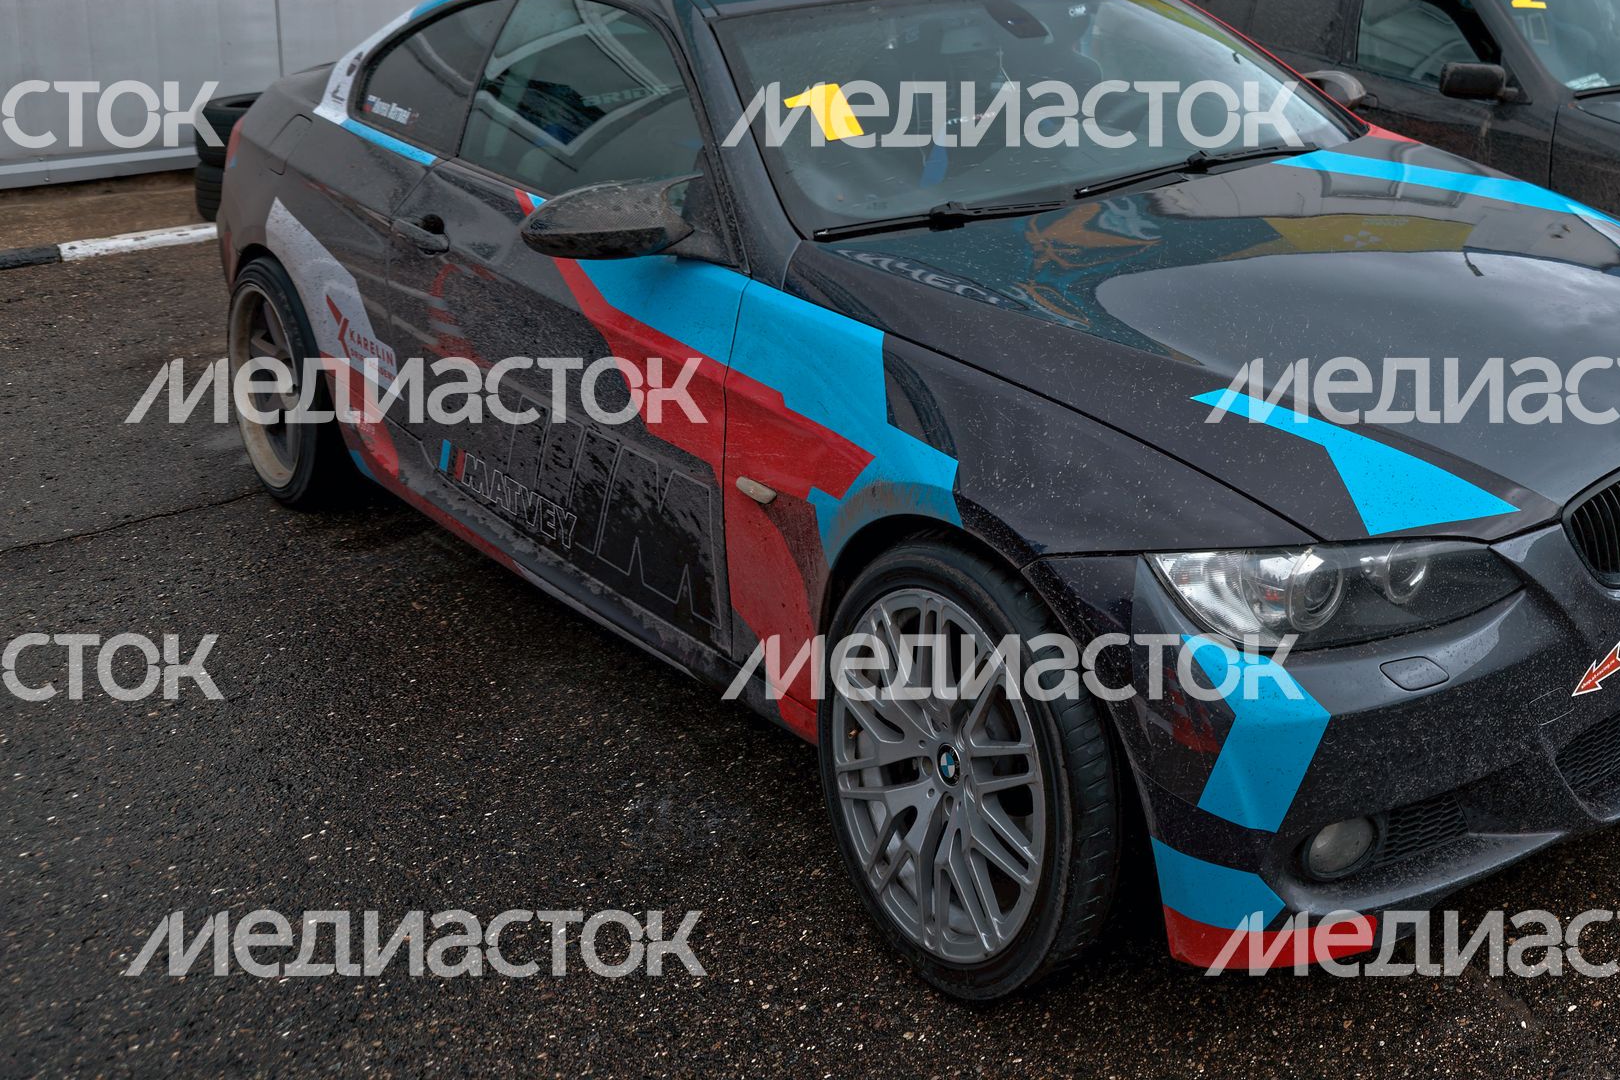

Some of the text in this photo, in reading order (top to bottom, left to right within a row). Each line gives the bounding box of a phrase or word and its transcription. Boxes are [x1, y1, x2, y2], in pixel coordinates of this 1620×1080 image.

[784, 83, 865, 141] 1
[349, 328, 394, 367] KARELIN
[461, 453, 577, 550] MATVEY
